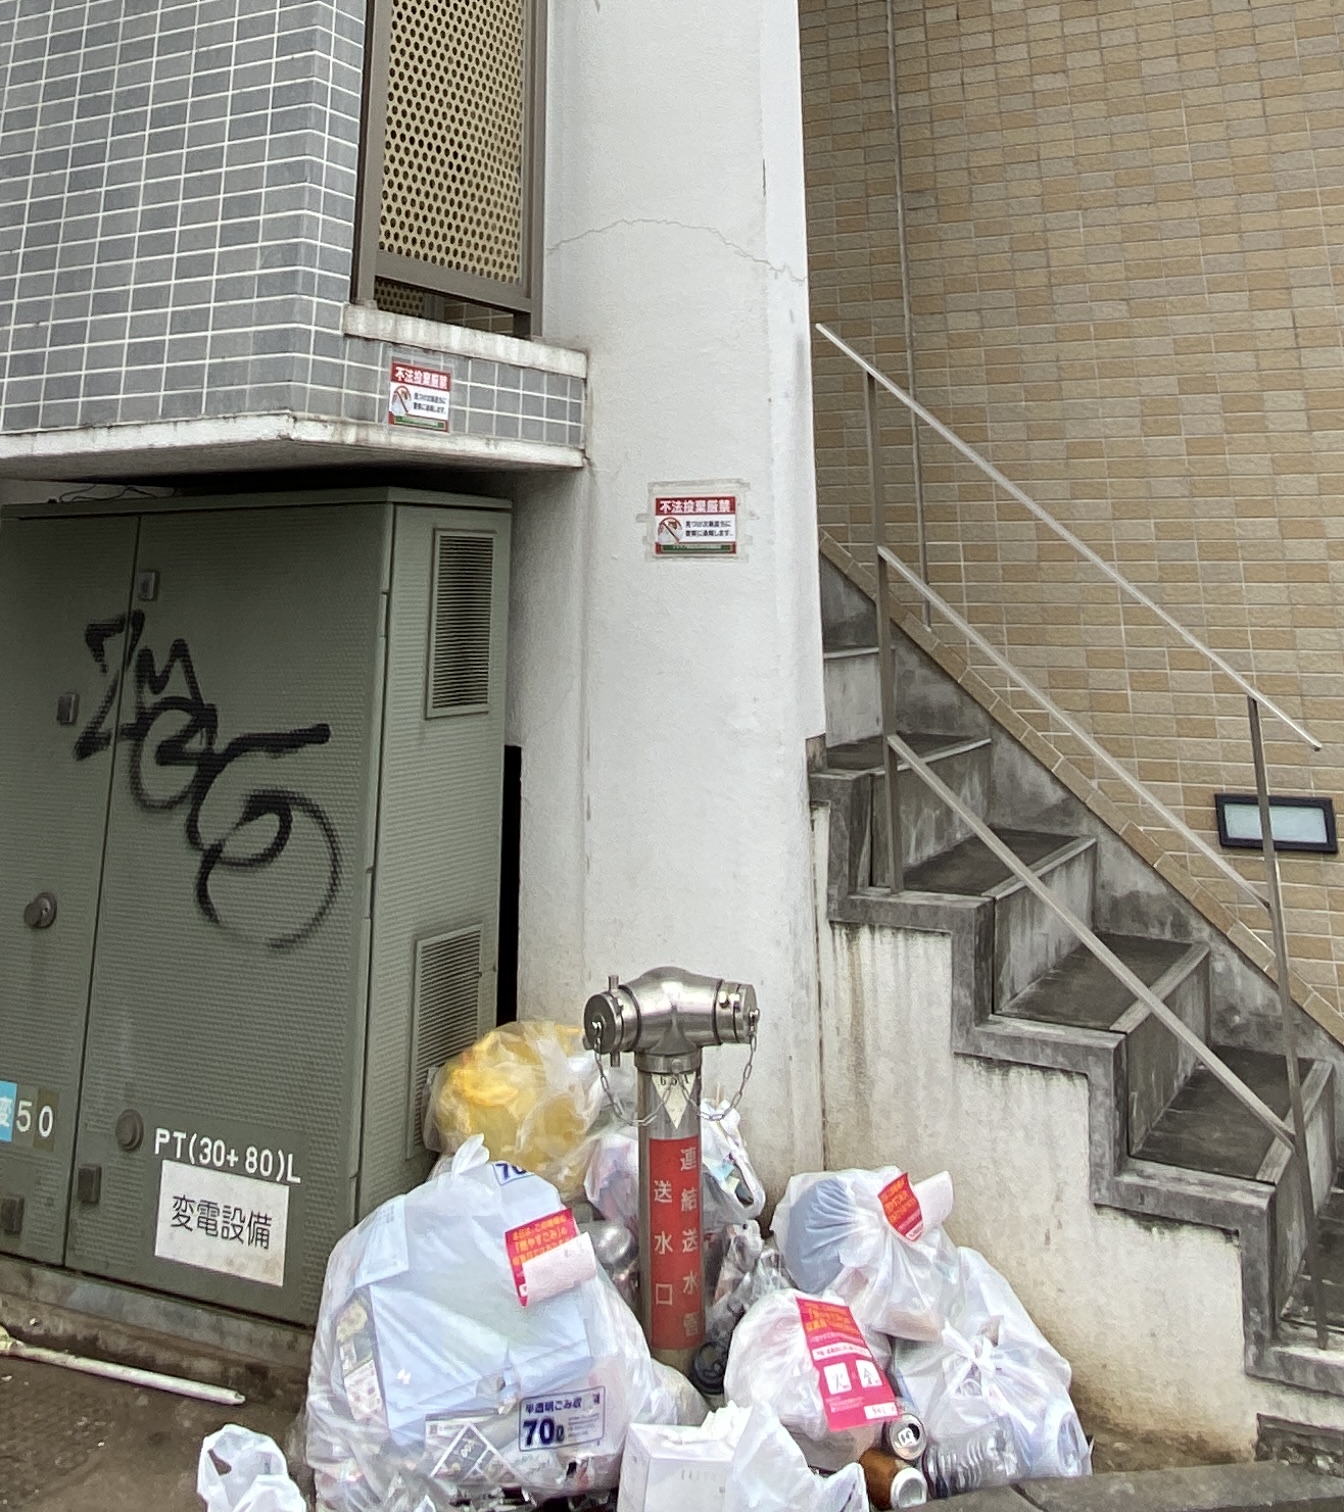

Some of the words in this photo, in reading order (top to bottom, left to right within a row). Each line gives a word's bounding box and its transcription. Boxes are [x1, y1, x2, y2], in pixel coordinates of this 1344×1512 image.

[170, 1194, 273, 1250] 変電設備
[654, 1180, 673, 1305] 送水口
[680, 1147, 700, 1338] 連結送水管
